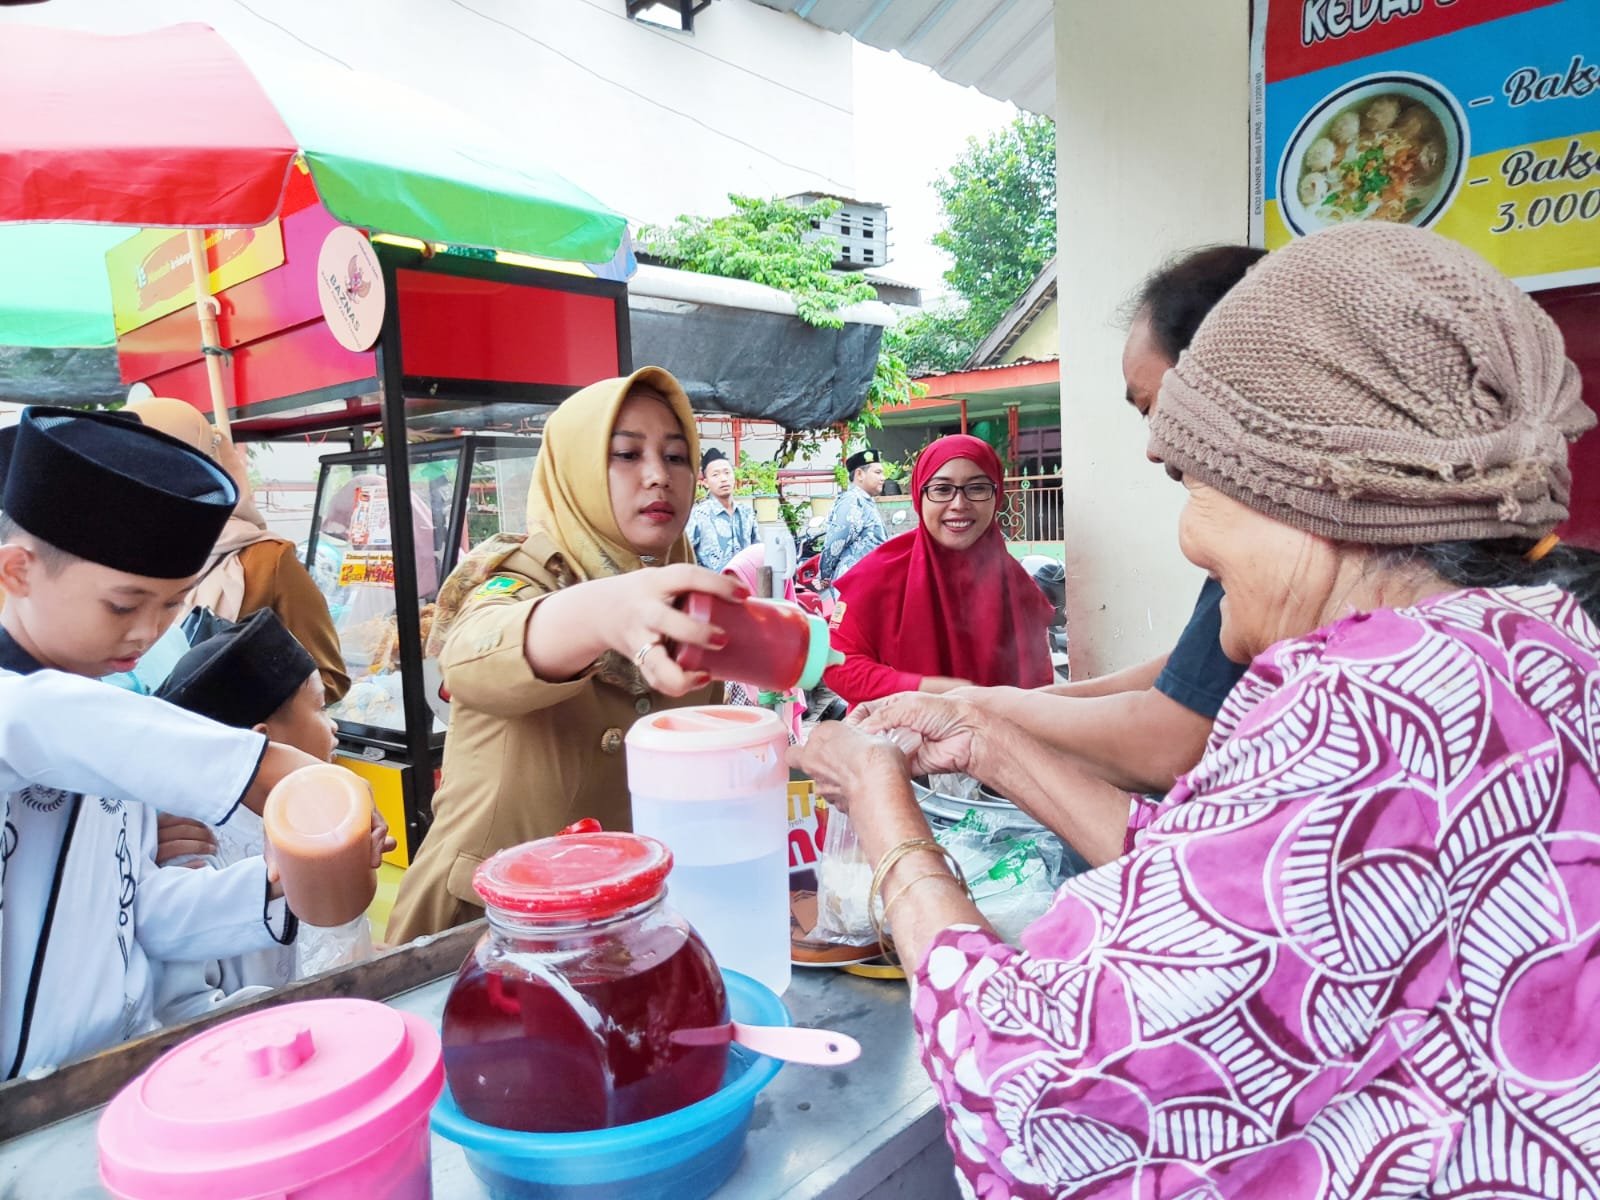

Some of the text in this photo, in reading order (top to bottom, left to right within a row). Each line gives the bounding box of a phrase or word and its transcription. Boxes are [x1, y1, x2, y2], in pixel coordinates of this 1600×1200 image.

[1503, 55, 1600, 107] Baks
[1501, 139, 1600, 187] Baks
[329, 273, 361, 332] BAZNAS
